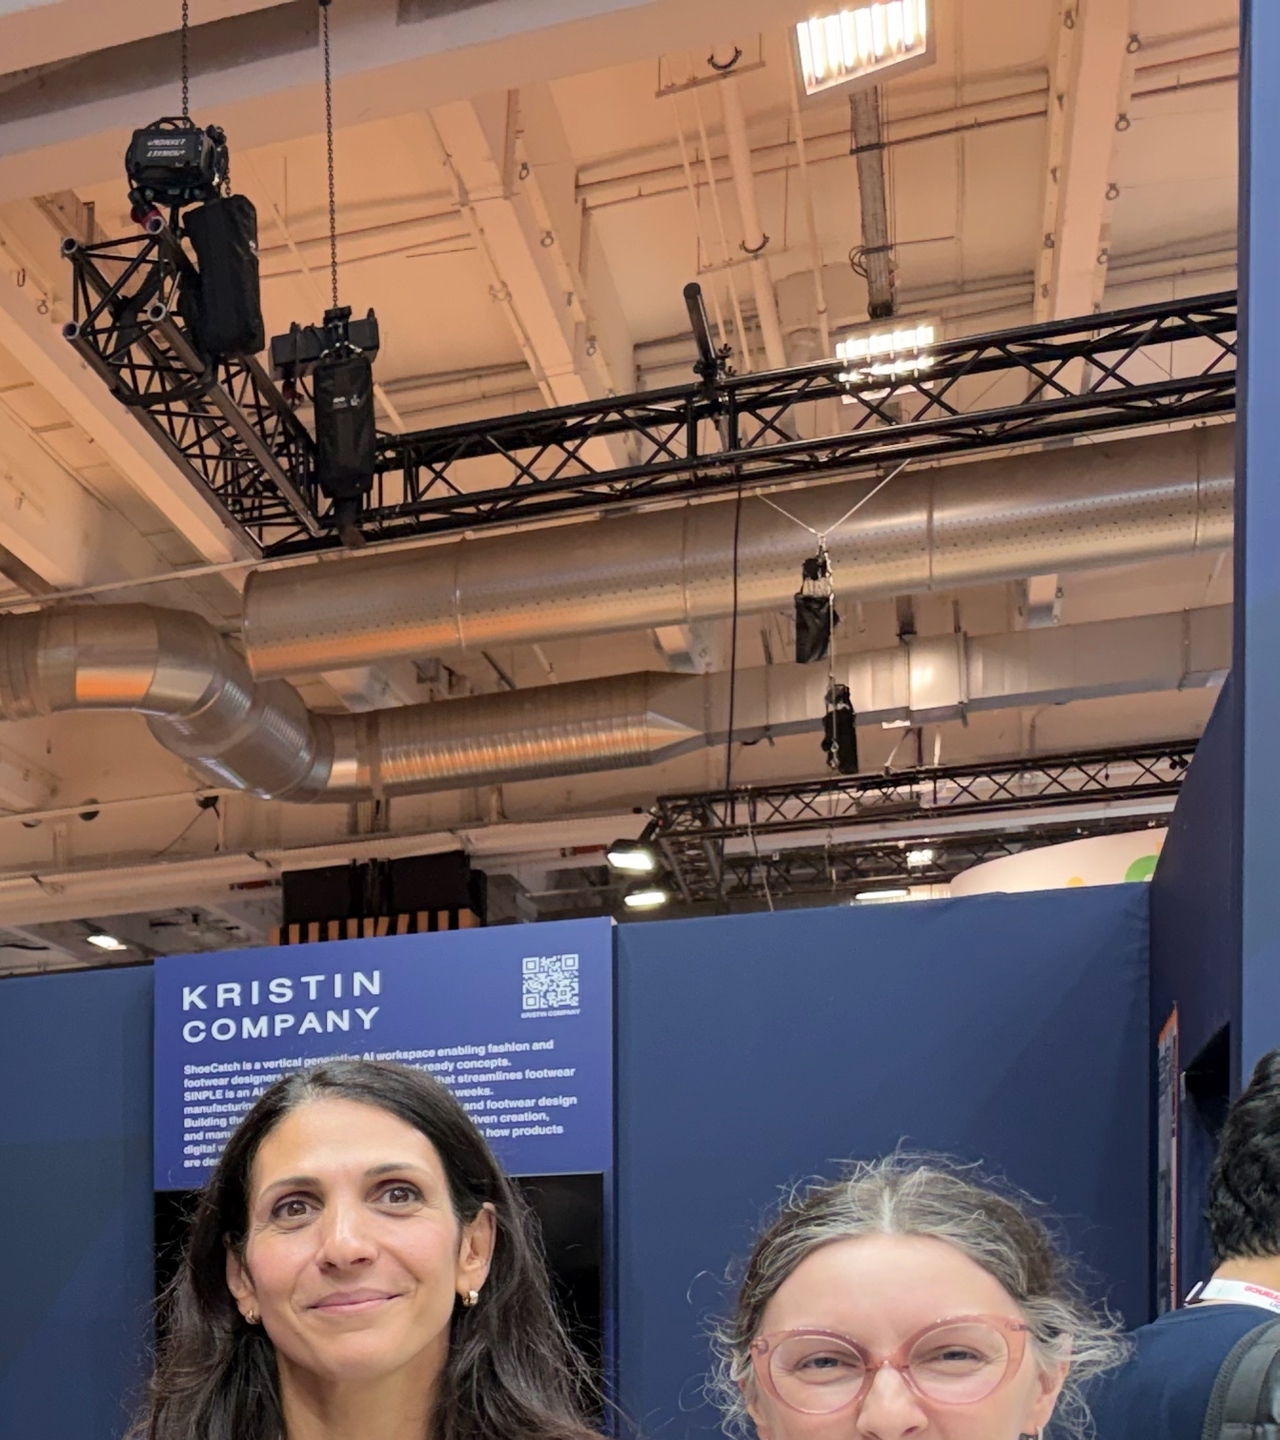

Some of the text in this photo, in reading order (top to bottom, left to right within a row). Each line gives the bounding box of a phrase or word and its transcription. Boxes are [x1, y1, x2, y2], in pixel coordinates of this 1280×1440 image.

[183, 970, 380, 1011] KRISTIN
[183, 1007, 380, 1043] COMPANY
[184, 1062, 241, 1075] ShoeCatch
[243, 1060, 252, 1070] is
[253, 1062, 260, 1070] a
[263, 1057, 302, 1069] vertical
[363, 1051, 374, 1061] AI
[376, 1049, 436, 1062] workspace
[437, 1044, 486, 1057] enabling
[488, 1042, 529, 1053] fashion
[532, 1039, 553, 1050] and
[184, 1076, 229, 1088] footwear
[456, 1058, 512, 1071] concepts.
[184, 1089, 223, 1101] SINPLE
[225, 1089, 235, 1099] is
[236, 1089, 250, 1098] an
[457, 1070, 523, 1083] streamlines
[525, 1067, 576, 1079] footwear
[184, 1086, 494, 1115] manufacturin weeks.
[184, 1118, 227, 1129] Building
[463, 1101, 484, 1111] and
[486, 1099, 536, 1110] footwear
[538, 1096, 578, 1108] design
[184, 1131, 204, 1142] and
[499, 1111, 550, 1123] creation,
[184, 1124, 564, 1156] digital how products
[184, 1157, 200, 1168] are
